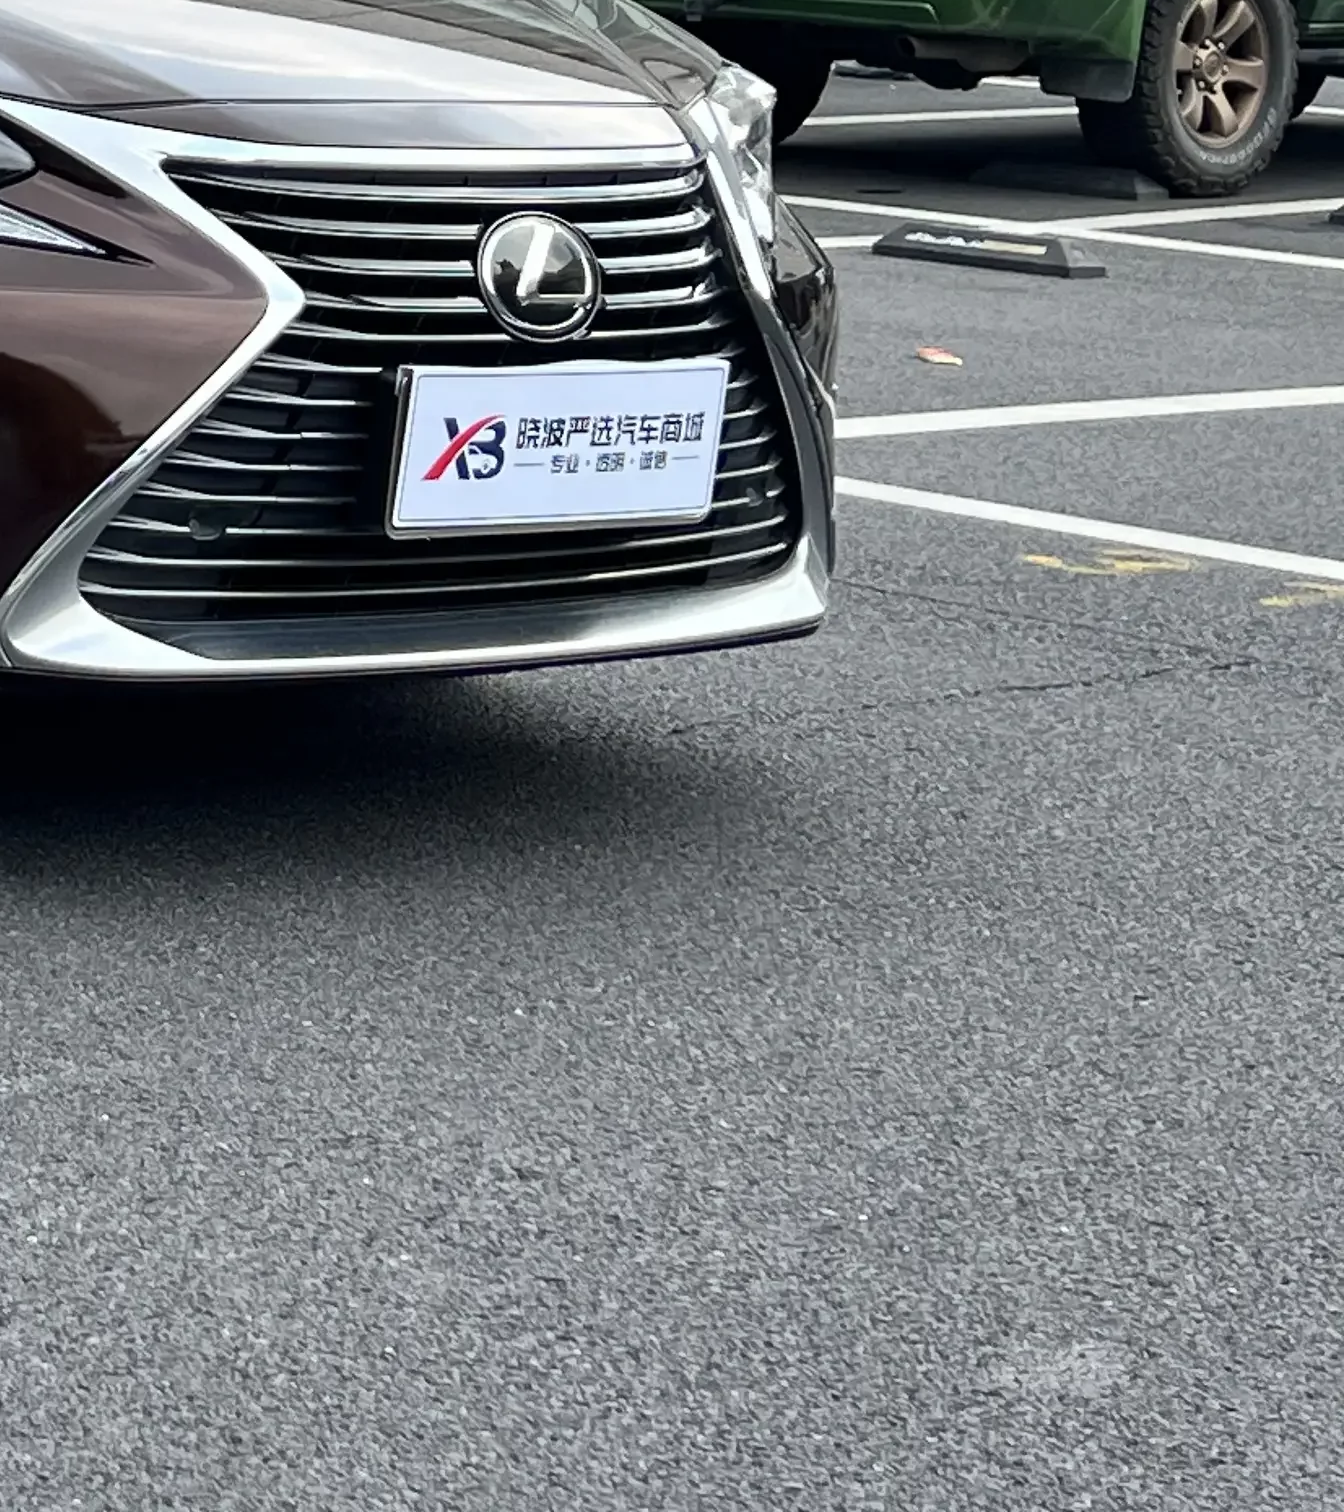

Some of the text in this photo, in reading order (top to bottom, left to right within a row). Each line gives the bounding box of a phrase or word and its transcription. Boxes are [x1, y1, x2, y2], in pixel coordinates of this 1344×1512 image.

[514, 410, 706, 450] 晓波严选汽车商城
